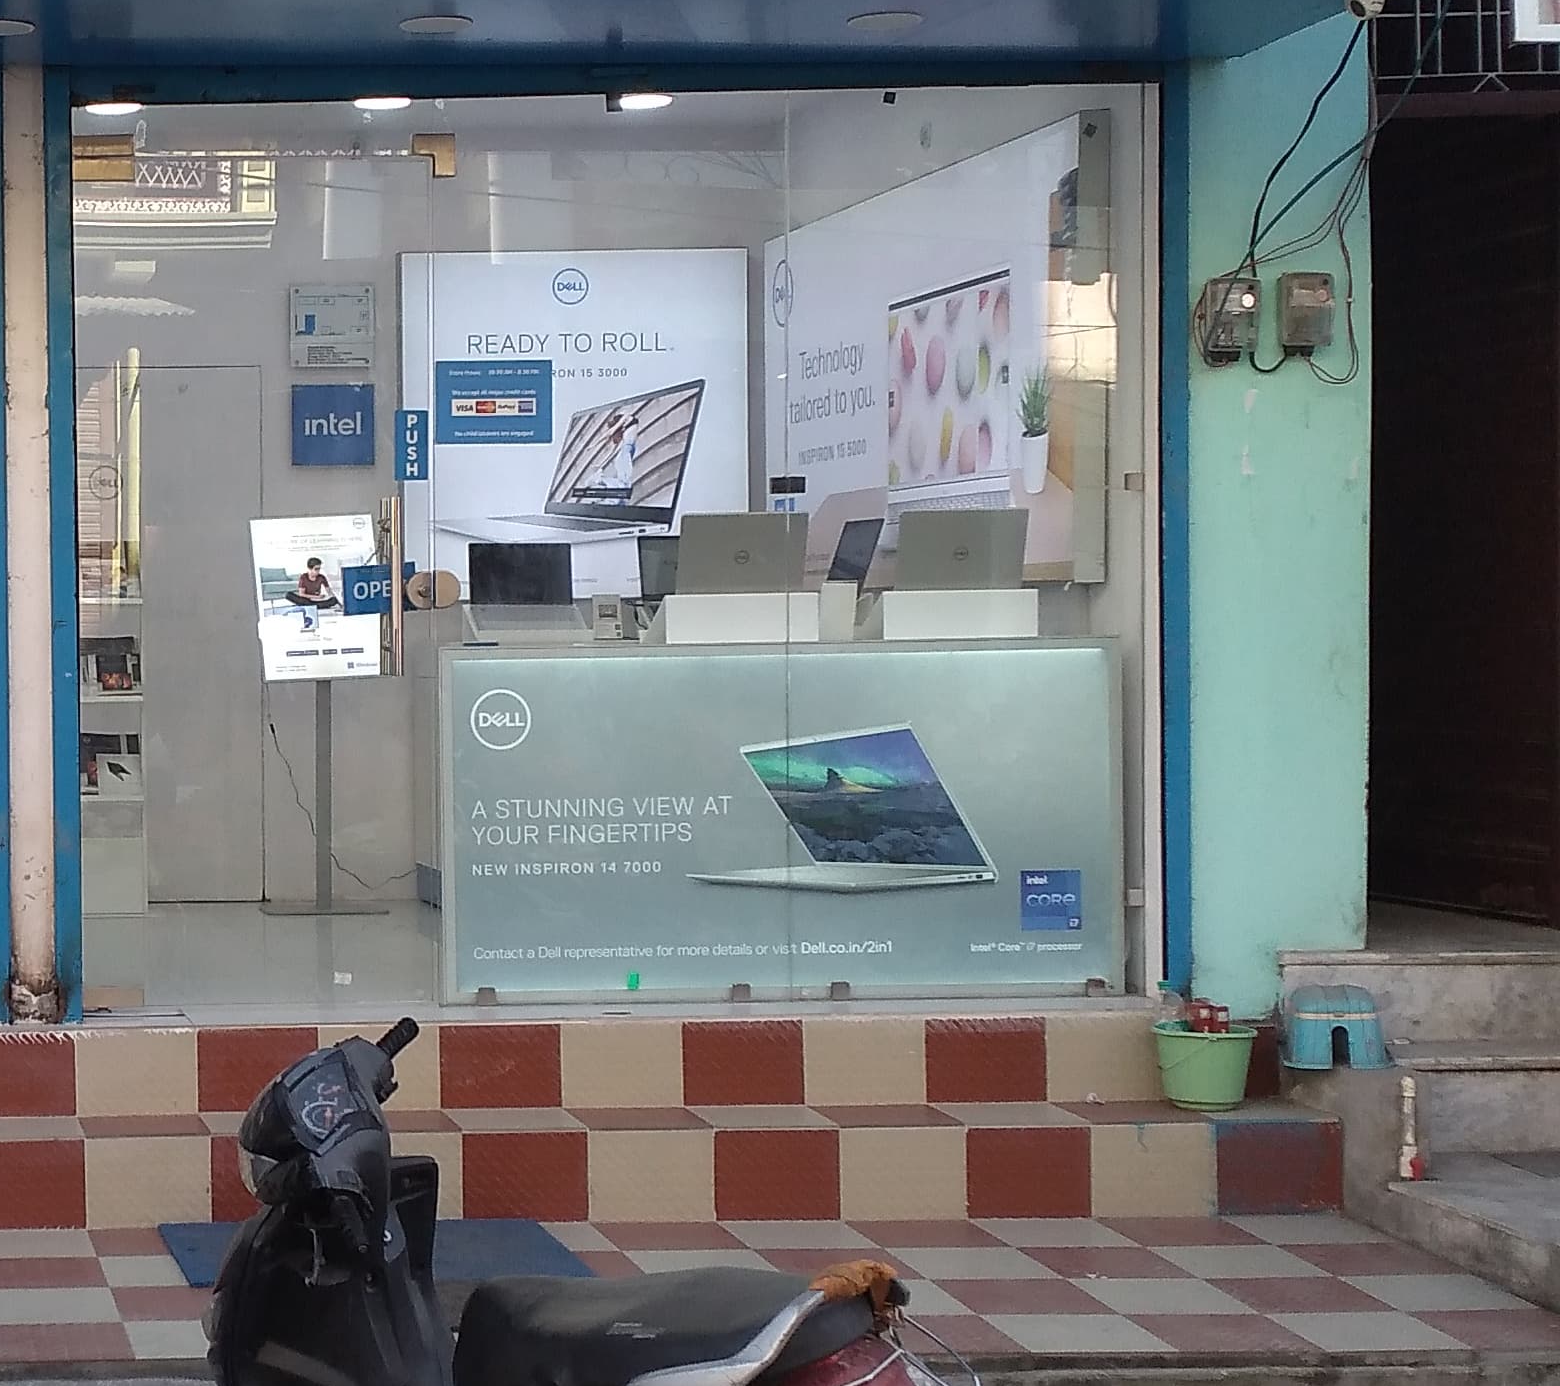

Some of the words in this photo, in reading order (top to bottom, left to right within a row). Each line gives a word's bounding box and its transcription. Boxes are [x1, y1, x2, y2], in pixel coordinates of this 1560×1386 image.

[557, 281, 585, 292] DELL
[467, 333, 550, 355] READY
[558, 332, 592, 353] TO
[799, 341, 865, 380] Technology
[581, 368, 593, 378] 15
[598, 368, 628, 378] 3000
[790, 388, 831, 424] tailored
[835, 388, 847, 415] to
[850, 384, 876, 417] you.
[304, 410, 363, 437] intel
[406, 414, 419, 477] PUSH
[798, 443, 836, 465] INSPIRON
[353, 579, 393, 600] OPE
[478, 712, 526, 728] DELL
[472, 800, 488, 819] A
[495, 797, 625, 819] STUNNING
[632, 796, 695, 816] VIEW
[703, 795, 733, 815] AT
[471, 824, 540, 845] YOUR
[548, 821, 693, 844] FINGERTIPS
[472, 864, 508, 876] NEW
[515, 862, 594, 875] INSPIRON
[600, 862, 617, 873] 14
[623, 861, 662, 874] 7000
[1026, 875, 1049, 885] intel
[473, 945, 524, 960] Contact
[526, 948, 536, 958] a
[538, 944, 562, 958] Dell
[564, 943, 654, 961] representative
[656, 942, 675, 957] for
[677, 944, 710, 957] more
[711, 941, 753, 956] details
[755, 943, 769, 955] or
[772, 941, 798, 955] visit
[801, 940, 893, 957] Dell.co.in/2in1
[1037, 942, 1083, 952] processor
